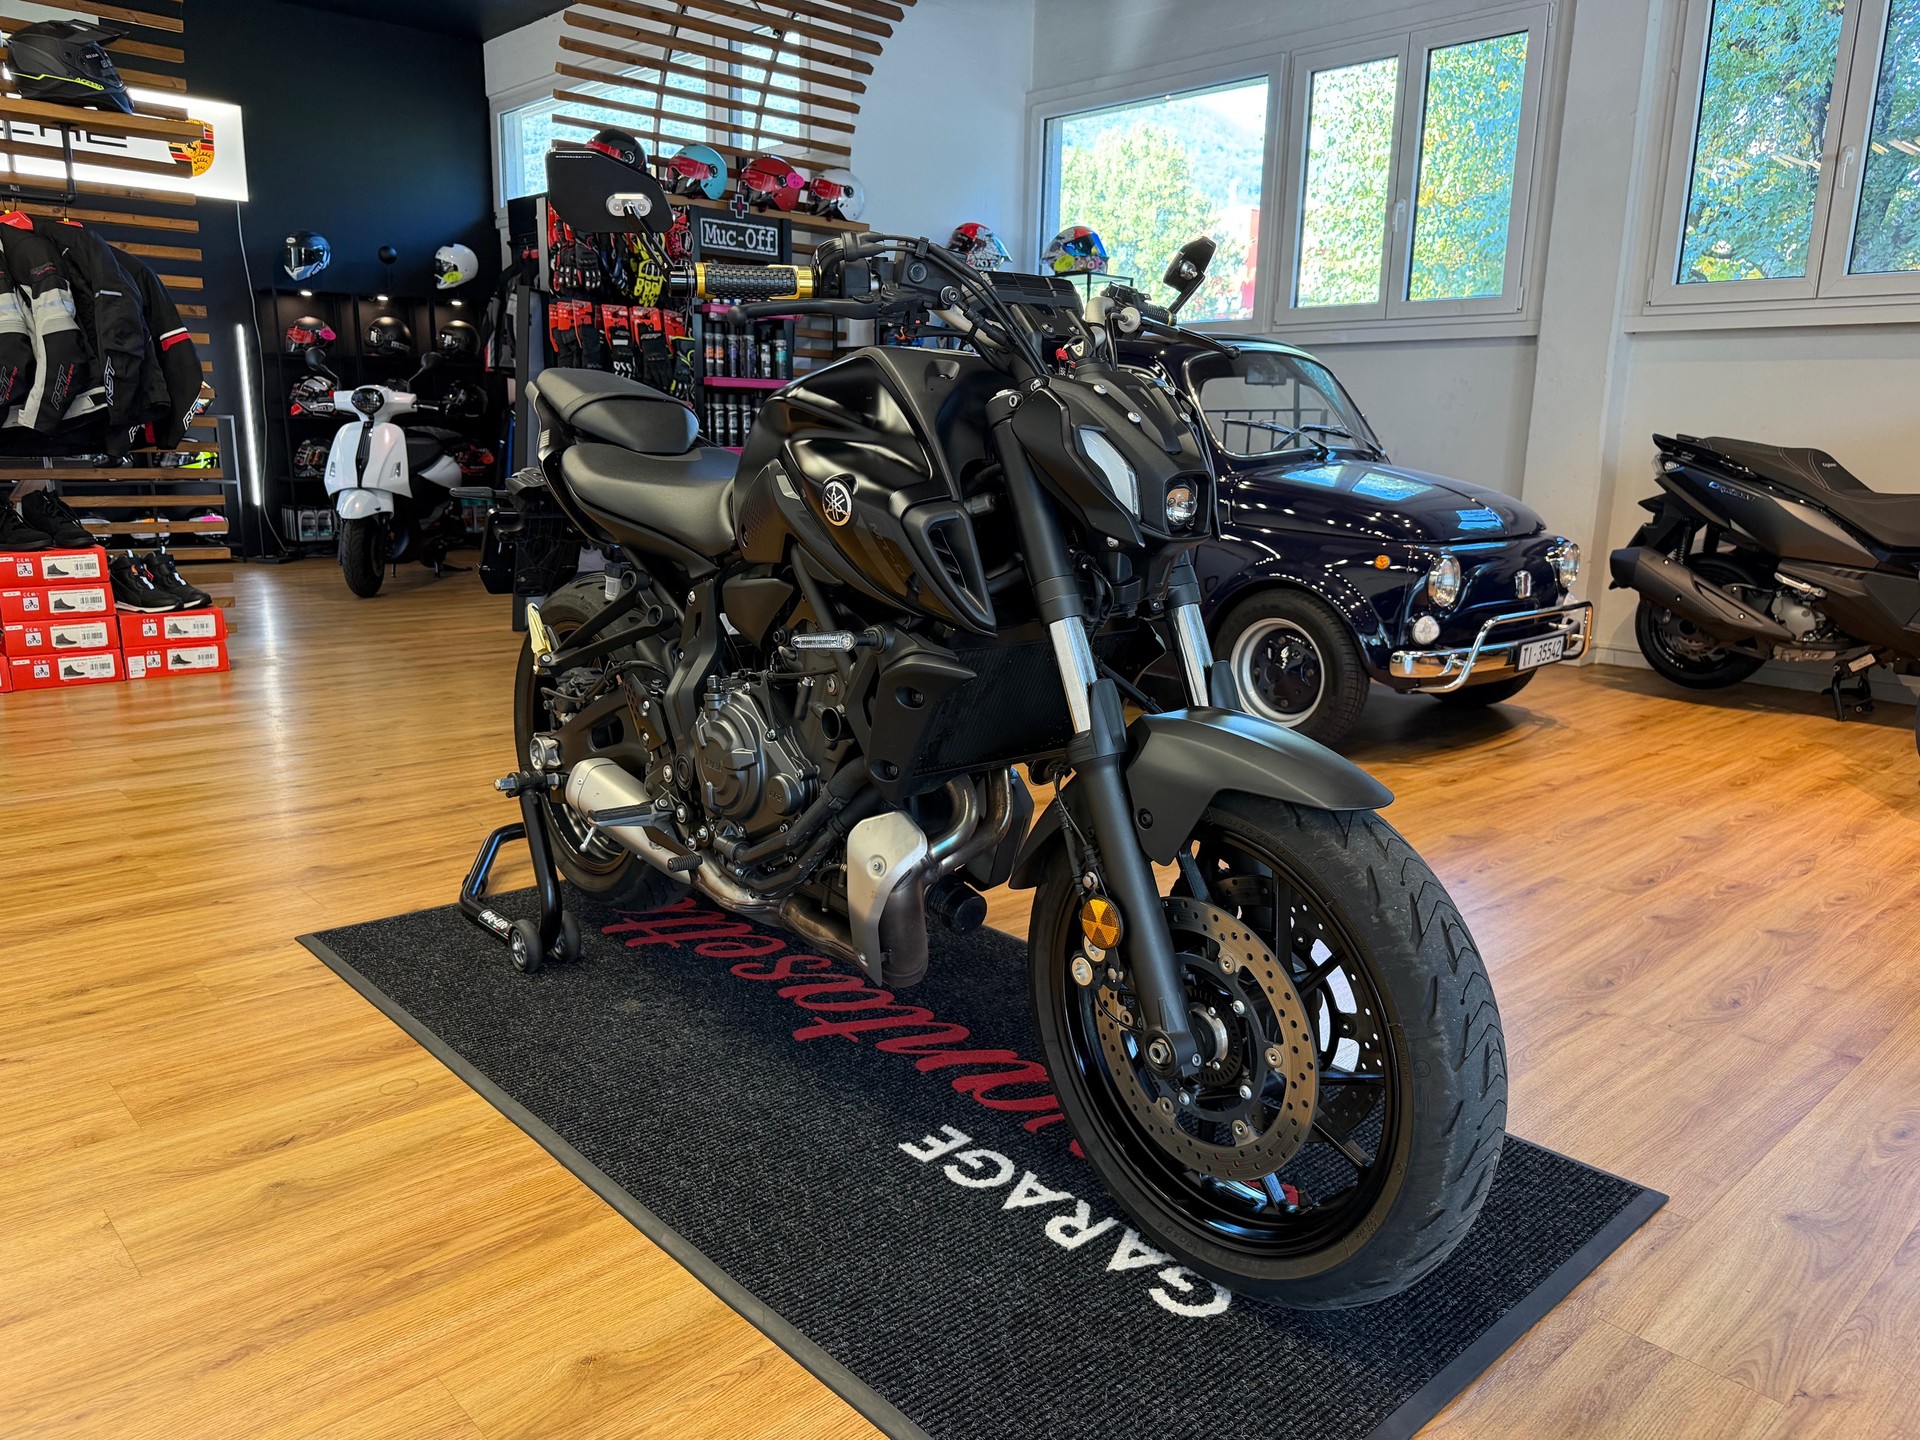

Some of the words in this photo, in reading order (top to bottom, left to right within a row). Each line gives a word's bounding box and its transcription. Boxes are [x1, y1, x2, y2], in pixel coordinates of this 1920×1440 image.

[704, 222, 775, 252] Muc-Off
[51, 363, 69, 411] RST
[103, 355, 116, 407] RST
[897, 1123, 1231, 1318] GARAGE
